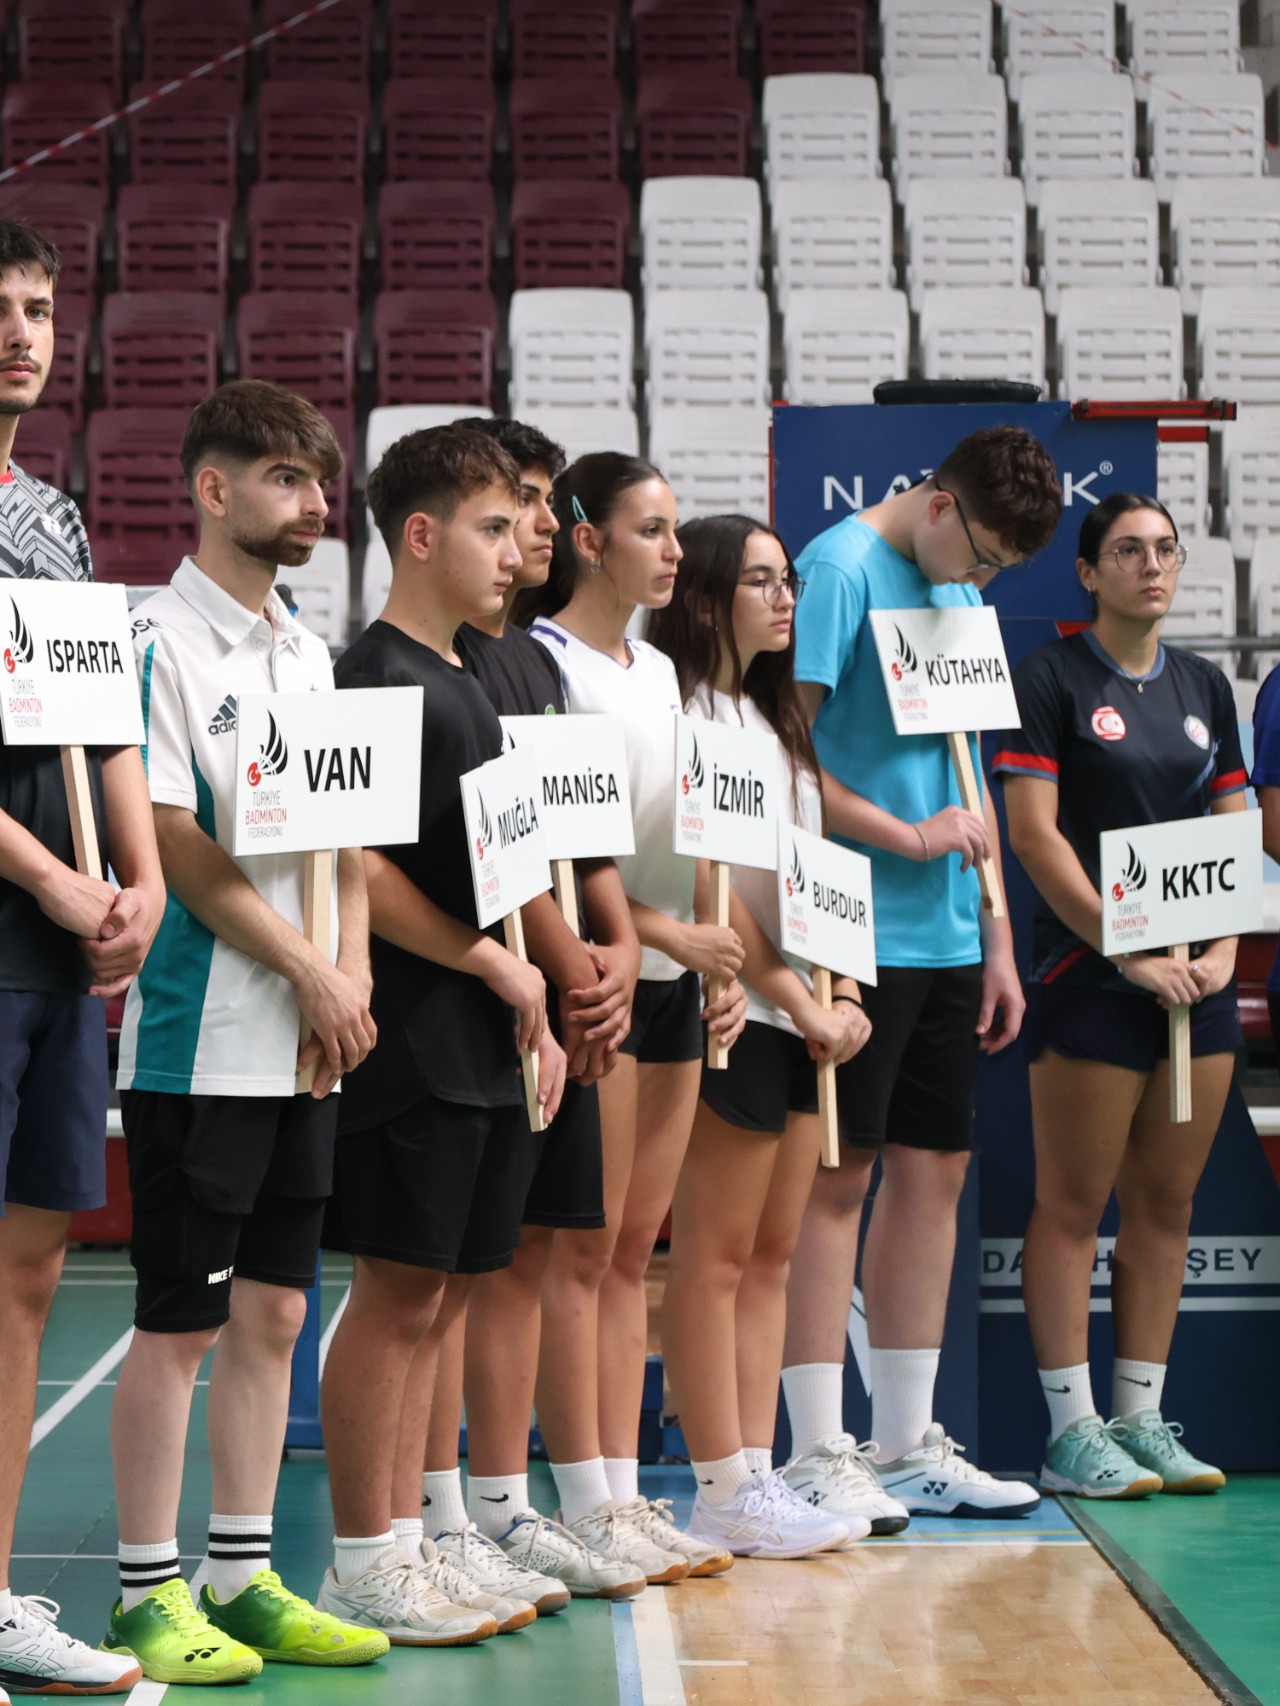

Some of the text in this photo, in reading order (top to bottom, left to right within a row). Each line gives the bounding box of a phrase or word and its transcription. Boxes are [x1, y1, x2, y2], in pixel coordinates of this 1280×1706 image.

[47, 639, 124, 674] ISPARTA
[925, 653, 1007, 686] KÜTAHYA
[304, 745, 372, 793] VAN
[542, 767, 620, 806] MANİSA
[713, 762, 764, 819] İZMİR
[497, 797, 539, 850] MUĞLA
[1162, 857, 1236, 902] KKTC
[813, 881, 867, 928] BURDUR
